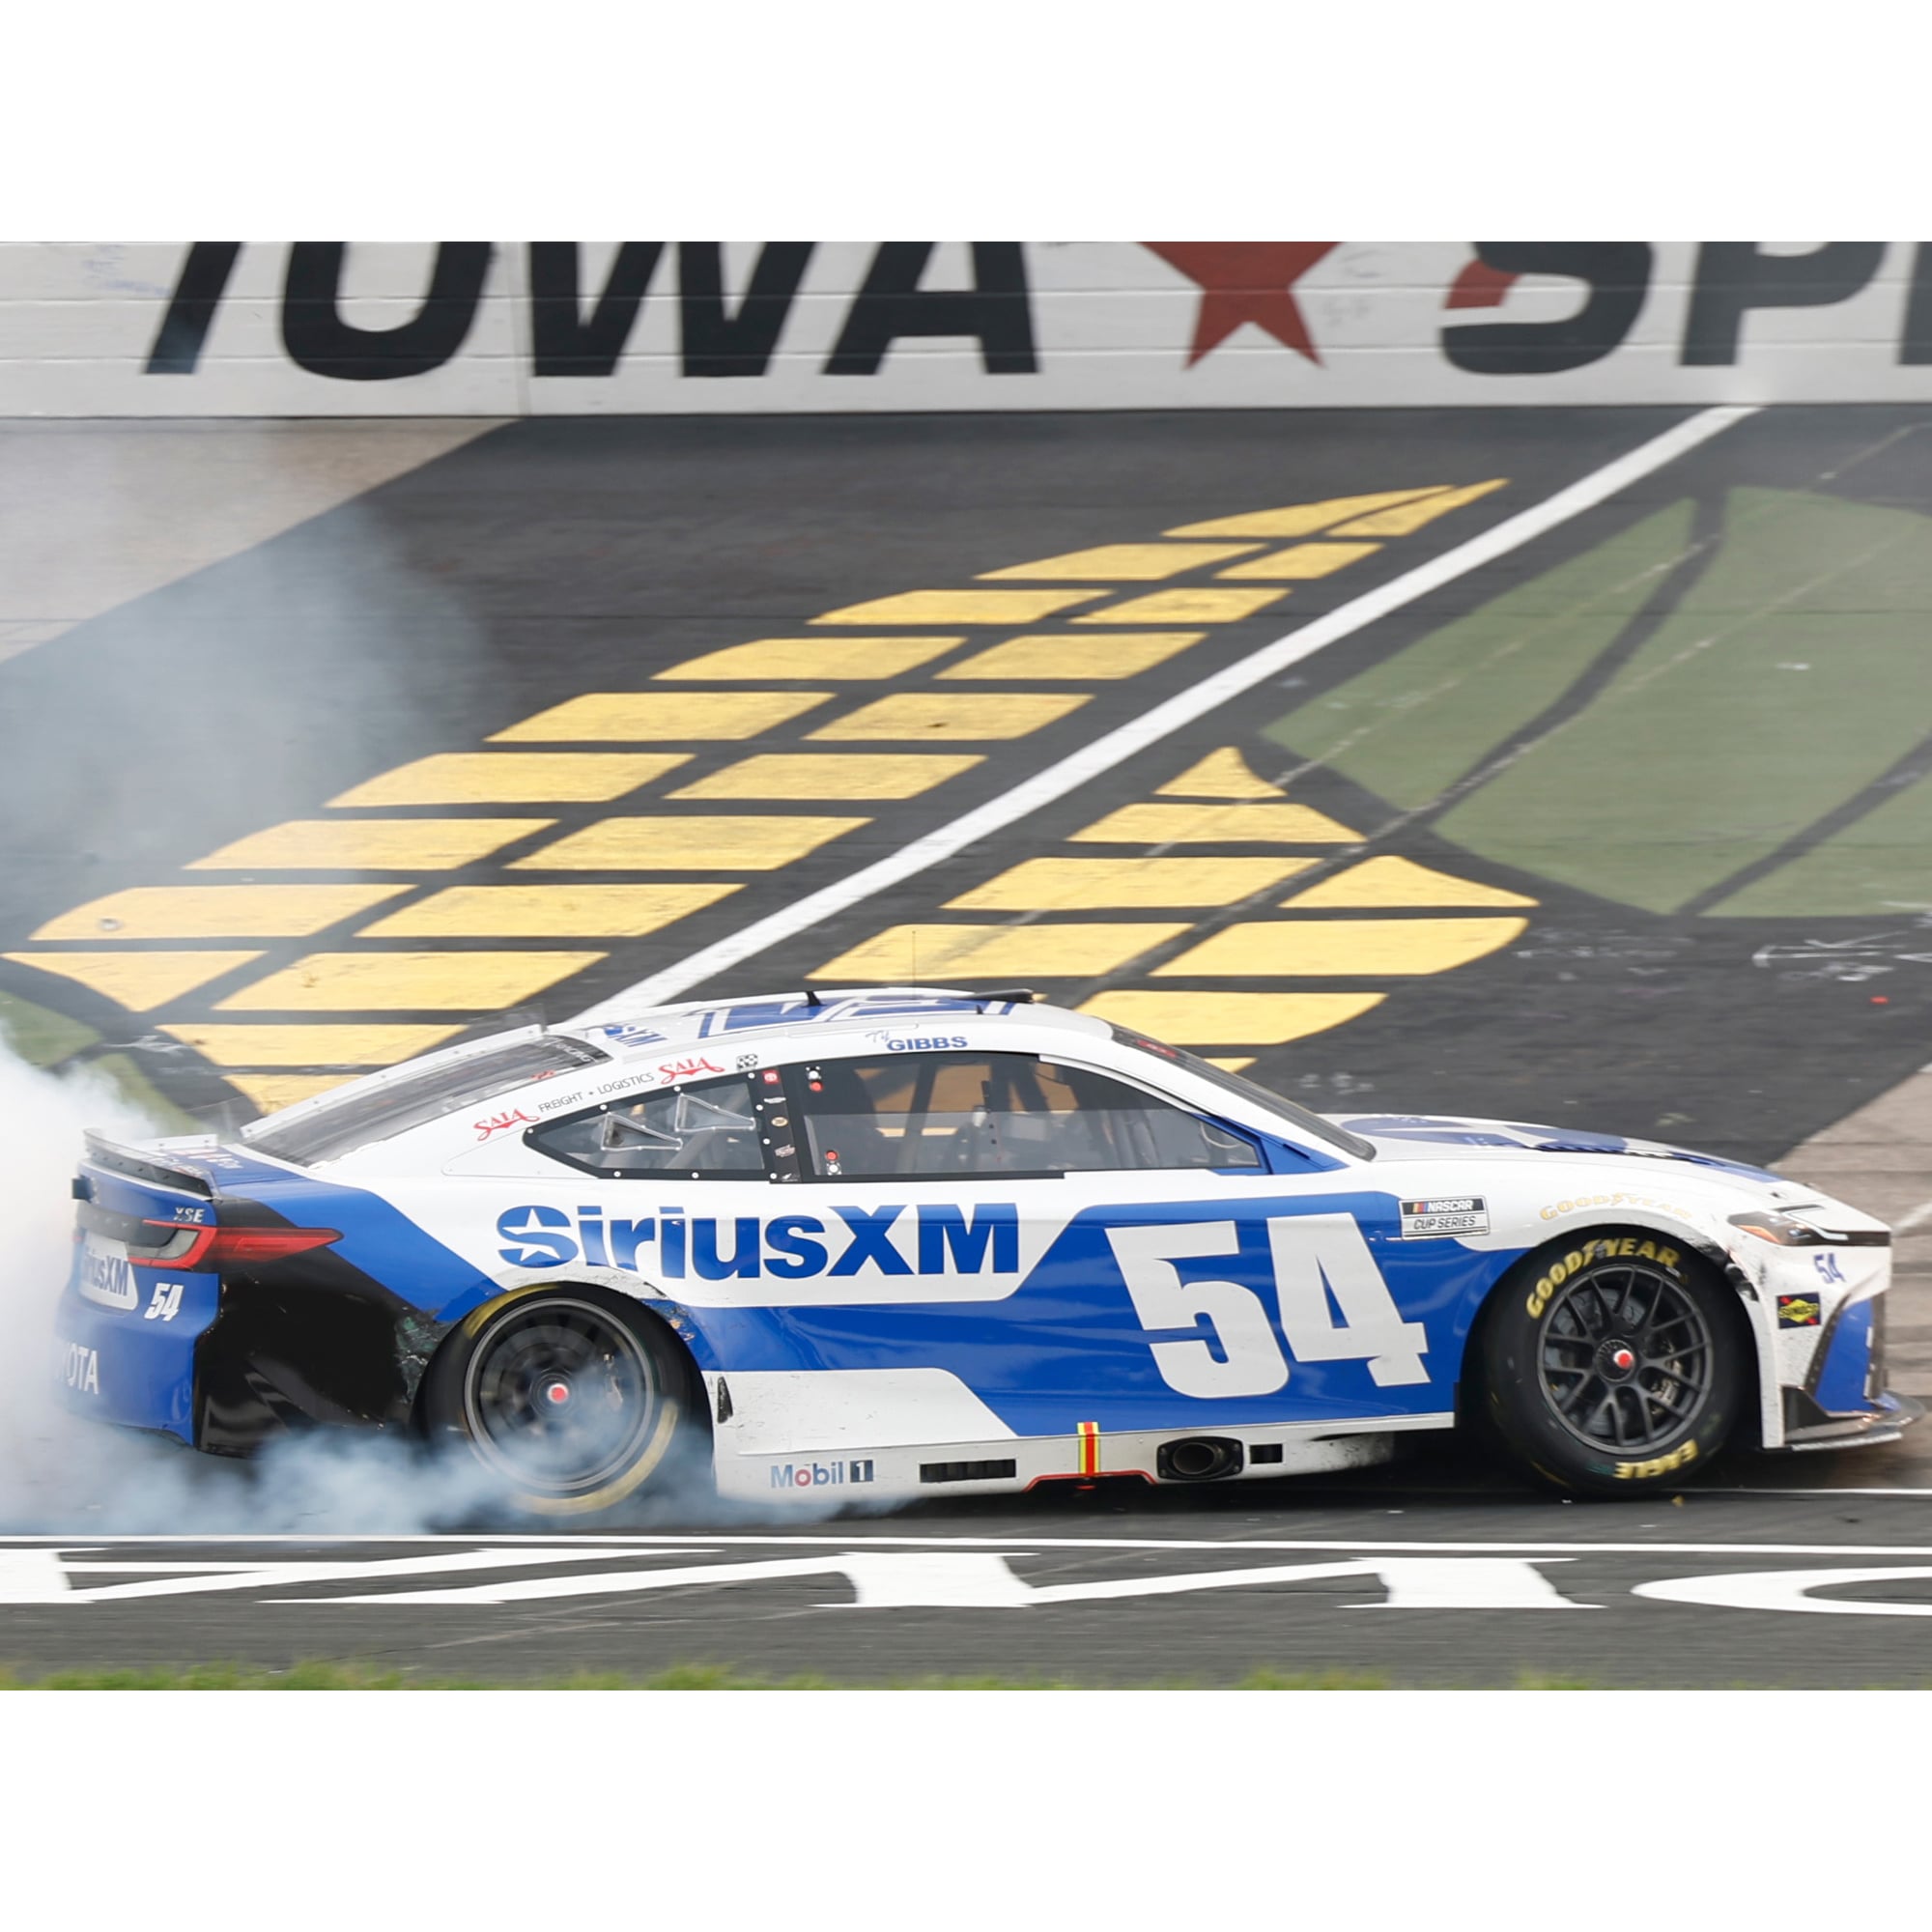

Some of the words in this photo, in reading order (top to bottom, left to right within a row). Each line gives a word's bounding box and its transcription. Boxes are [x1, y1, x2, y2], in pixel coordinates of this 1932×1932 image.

[145, 242, 1041, 381] IOWA
[1440, 242, 1932, 375] SP
[887, 1036, 969, 1052] GIBBS
[659, 1057, 725, 1085] SAIA
[538, 1094, 584, 1112] FREIGHT
[597, 1072, 655, 1095] LOGISTICS
[473, 1108, 541, 1142] SAIA
[174, 1206, 206, 1224] XSE
[1413, 1218, 1436, 1230] CUP
[1437, 1215, 1476, 1229] SERIES
[1428, 1200, 1474, 1213] NASCAR
[497, 1203, 1019, 1280] SiriusXM
[1526, 1237, 1681, 1320] GOODYEAR
[1814, 1252, 1847, 1285] 54
[144, 1282, 185, 1321] 54
[1104, 1212, 1432, 1399] 54
[770, 1461, 843, 1489] Mobil
[854, 1460, 868, 1482] 1
